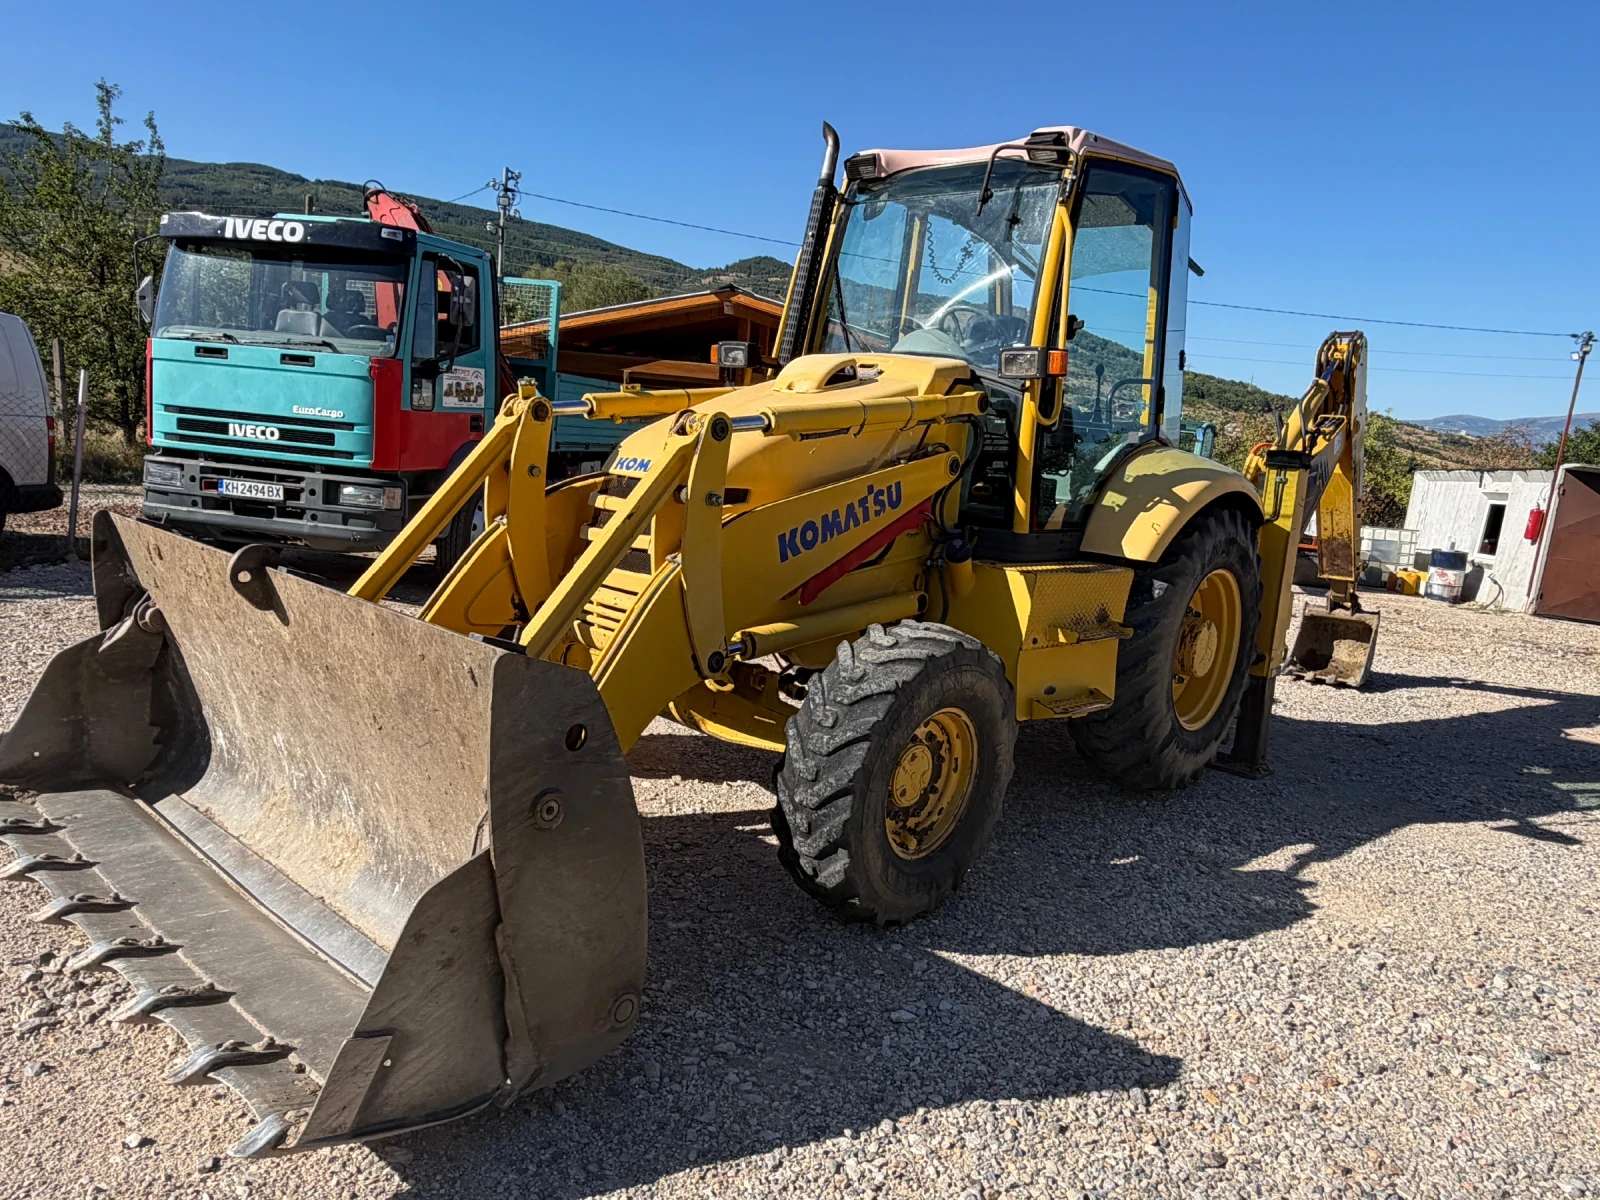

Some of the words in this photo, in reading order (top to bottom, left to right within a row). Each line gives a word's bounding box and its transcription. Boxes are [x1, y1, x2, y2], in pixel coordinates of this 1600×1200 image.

[224, 217, 305, 242] IVECO
[292, 405, 344, 418] EuroCargo
[228, 423, 280, 440] IVECO
[777, 480, 902, 563] KOMATSU
